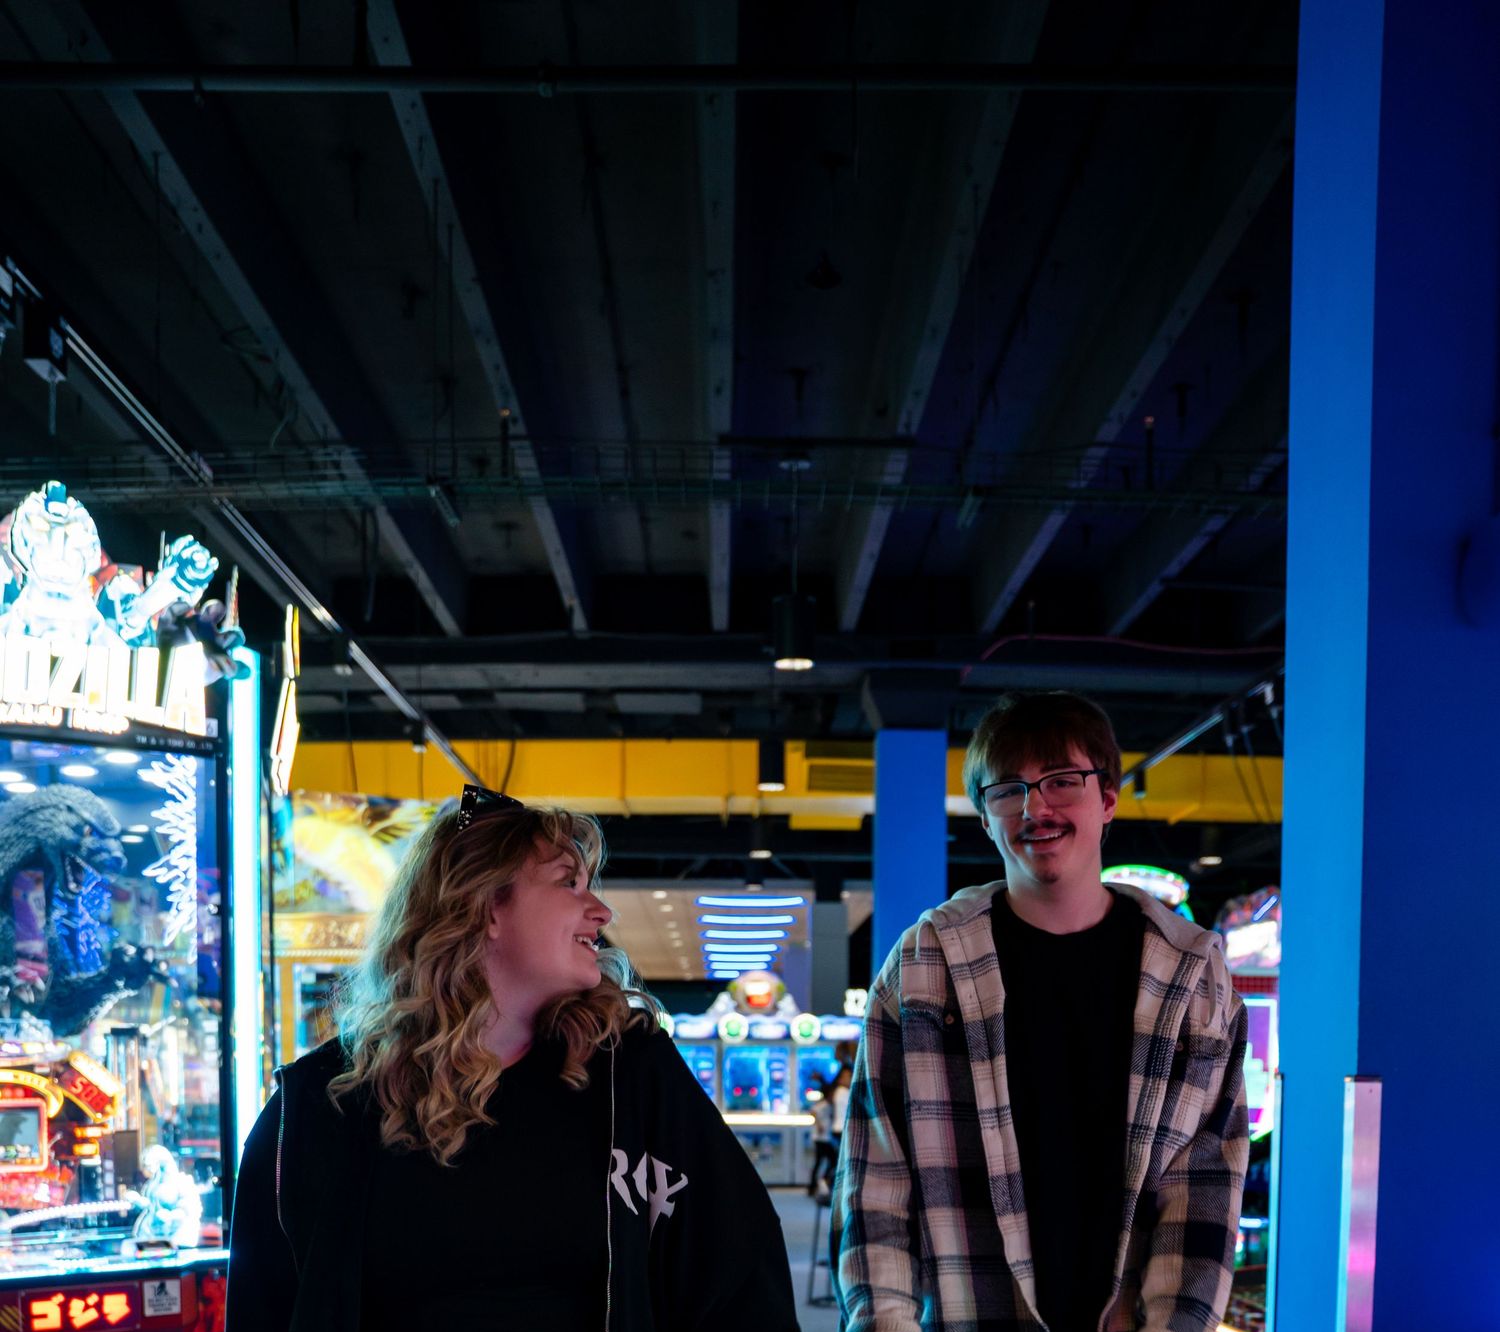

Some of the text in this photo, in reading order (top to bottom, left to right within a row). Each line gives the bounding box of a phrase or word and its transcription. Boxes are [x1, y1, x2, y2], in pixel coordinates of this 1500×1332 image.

[0, 634, 206, 736] DZILLA
[30, 1292, 131, 1331] ゴジラ
